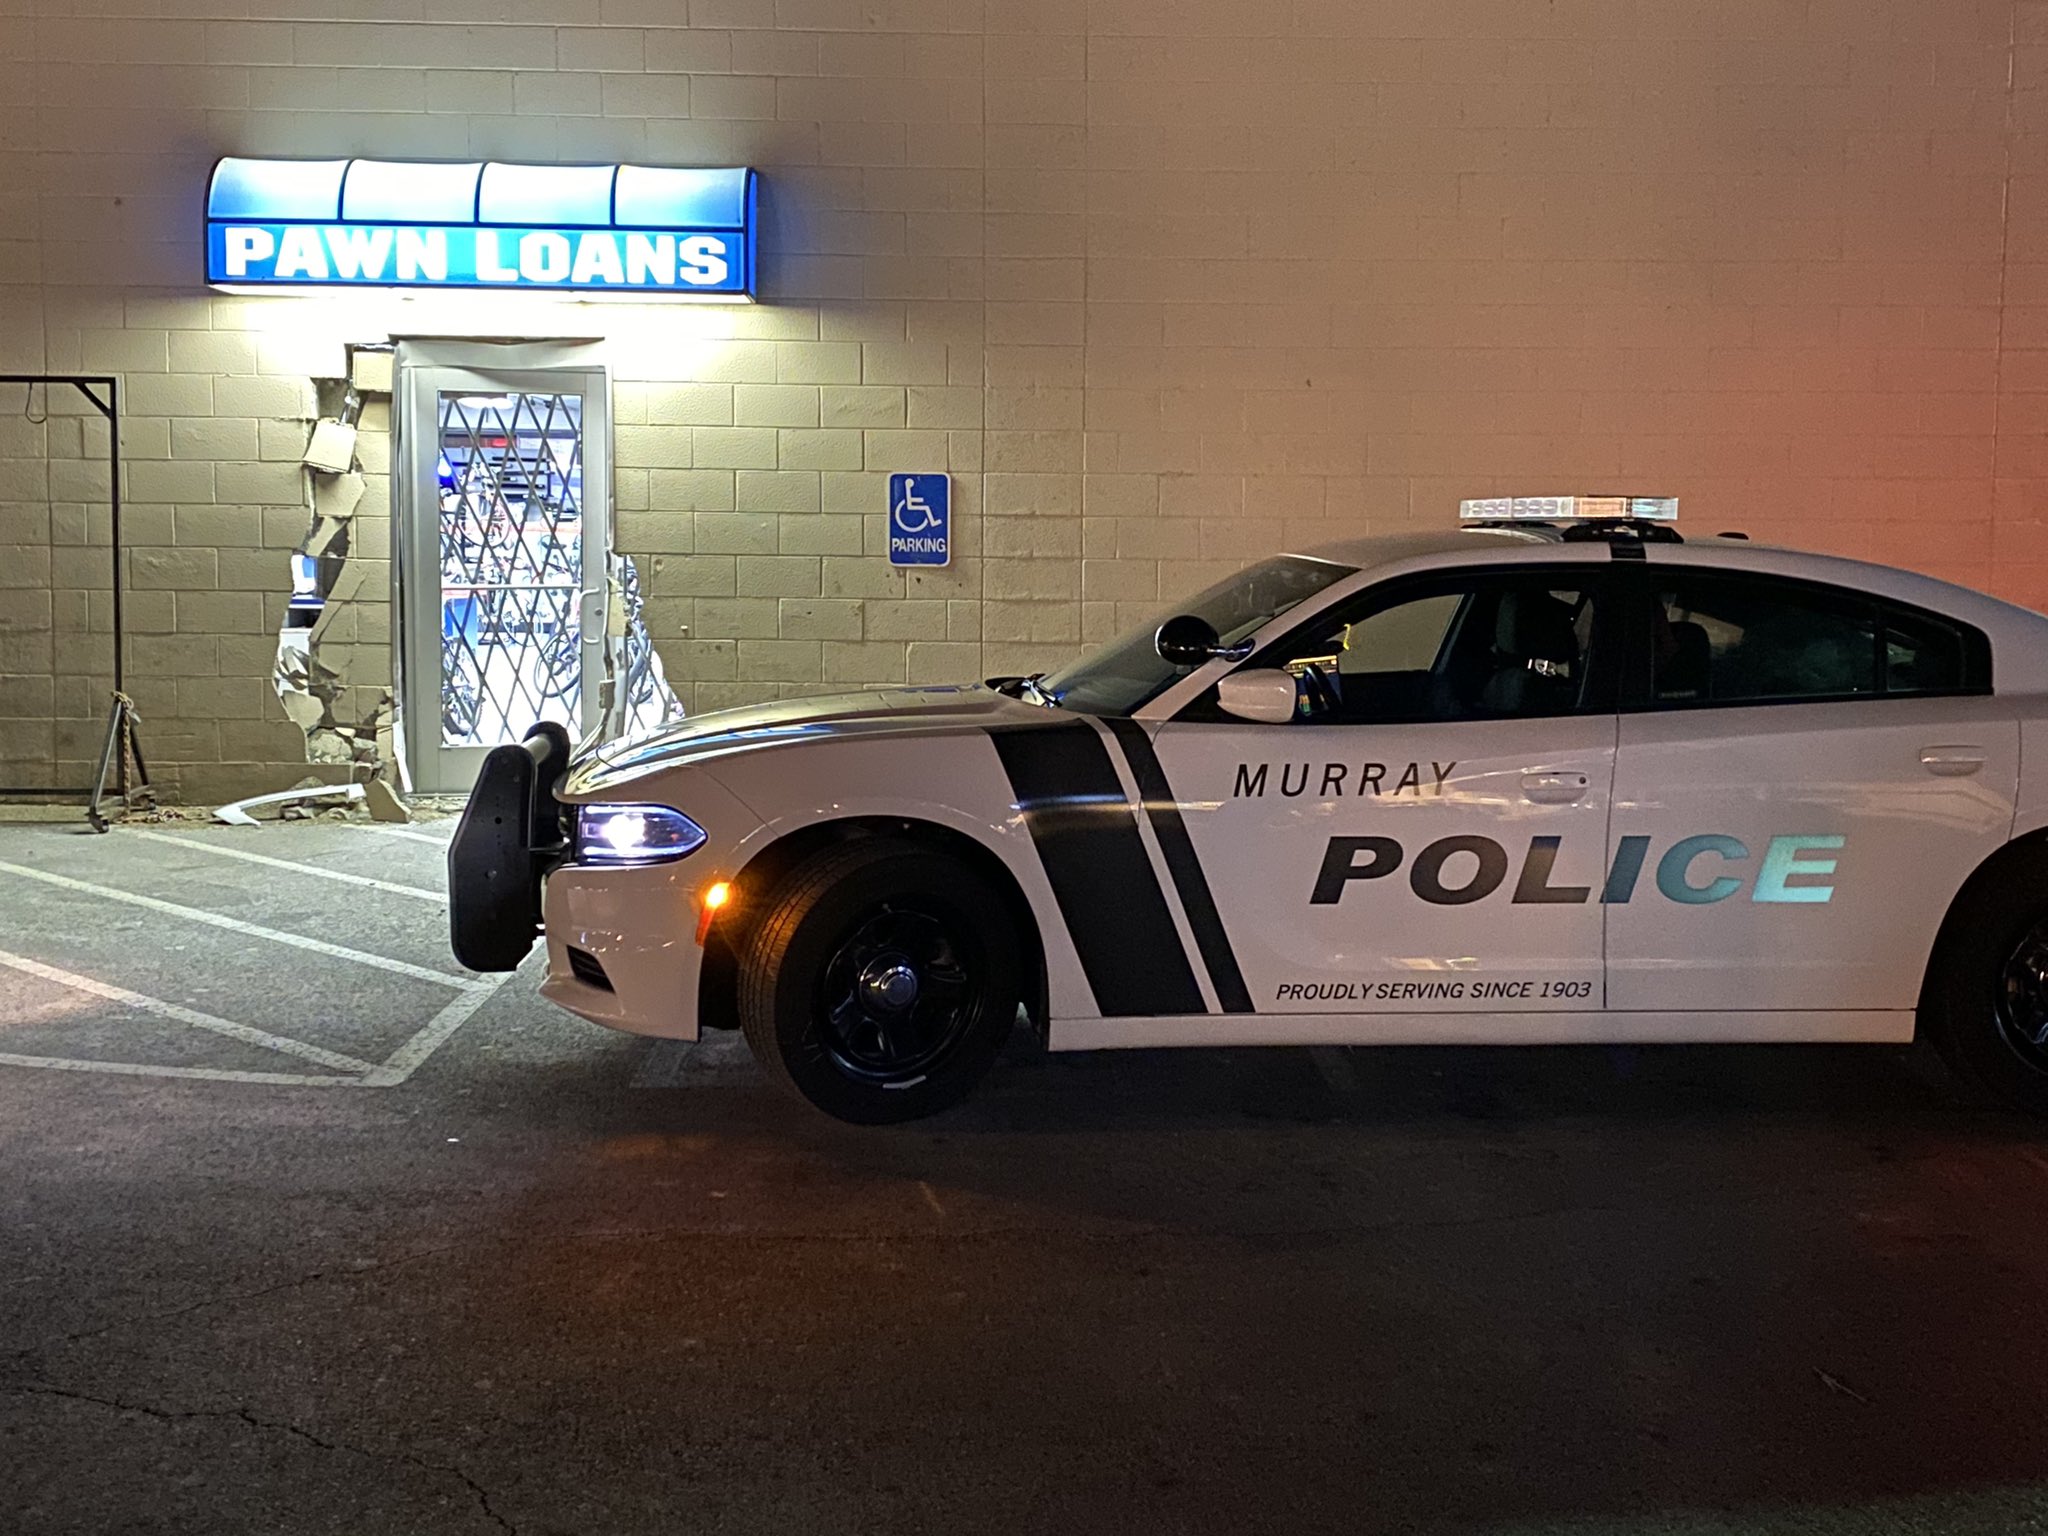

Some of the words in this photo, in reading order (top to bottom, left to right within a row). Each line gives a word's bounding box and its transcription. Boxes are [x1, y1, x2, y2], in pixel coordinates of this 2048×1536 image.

[224, 226, 448, 280] PAWN
[475, 229, 728, 285] LOANS
[891, 537, 947, 553] PARKING
[1233, 760, 1458, 798] MURRAY
[1309, 833, 1847, 906] POLICE
[1276, 983, 1374, 1000] PROUDLY
[1375, 982, 1465, 999] SERVING
[1470, 981, 1534, 998] SINCE
[1539, 981, 1592, 998] 1903
